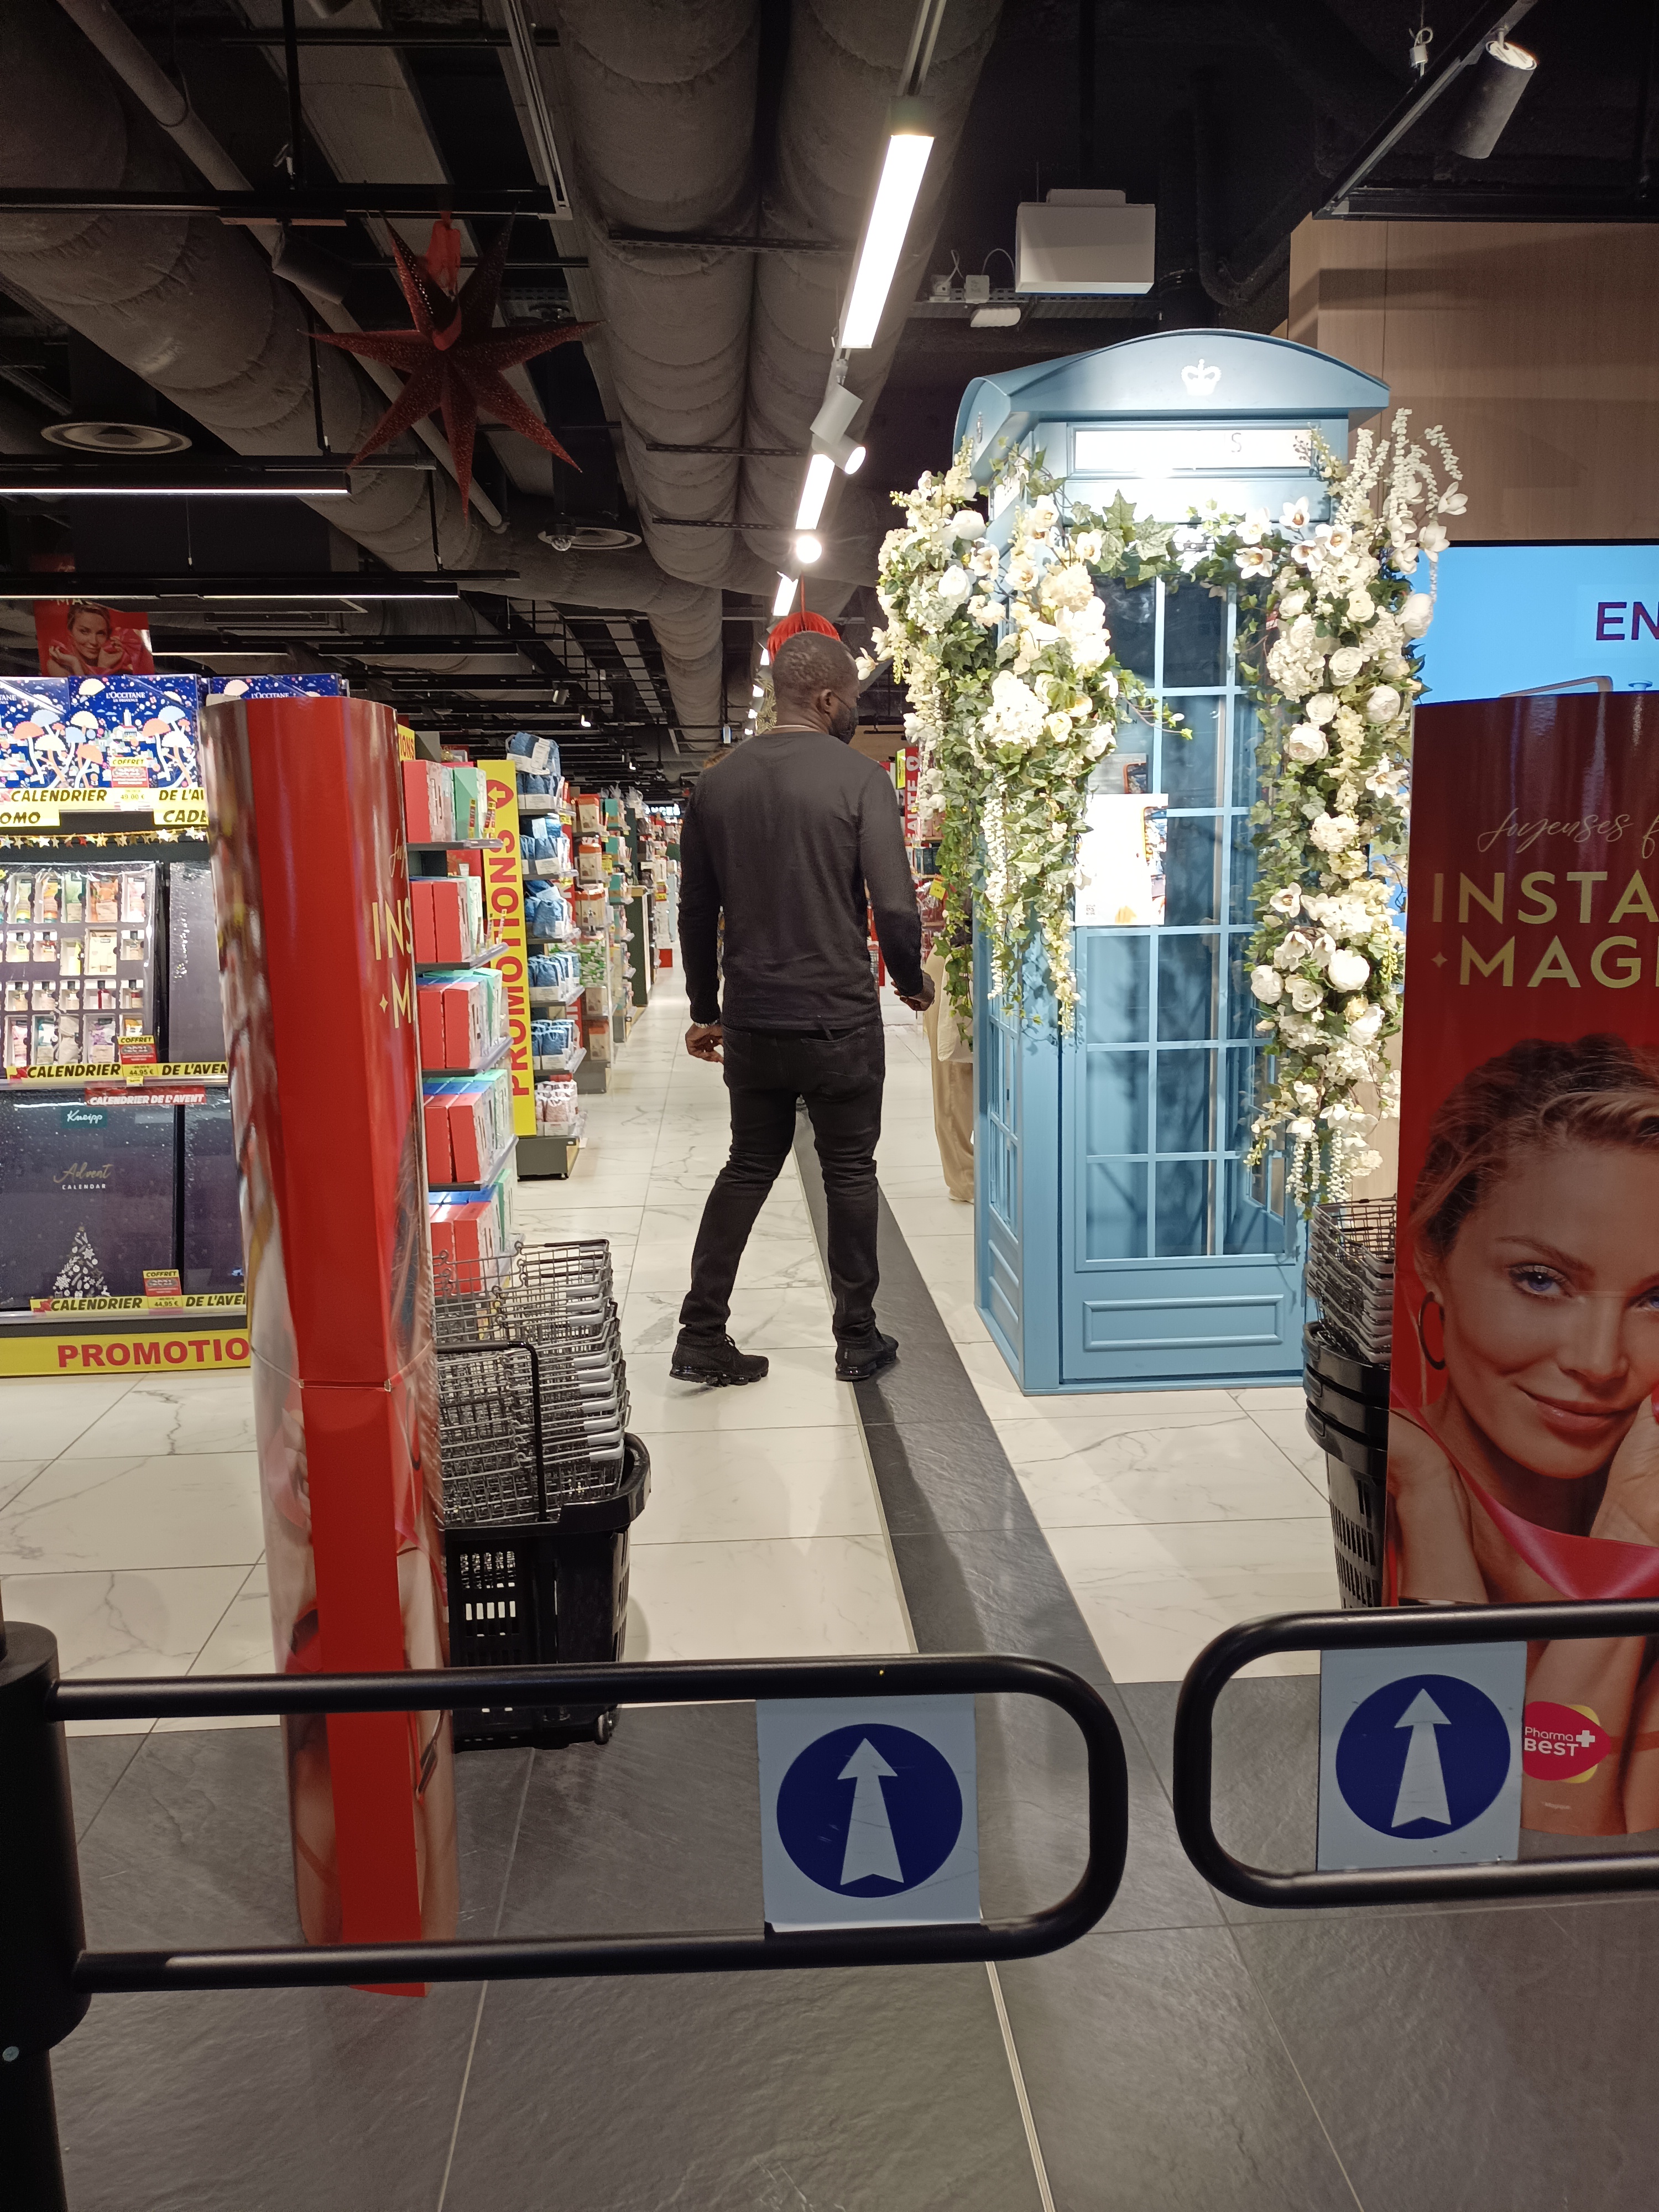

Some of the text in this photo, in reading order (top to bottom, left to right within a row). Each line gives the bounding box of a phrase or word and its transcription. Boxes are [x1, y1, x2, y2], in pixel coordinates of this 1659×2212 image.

[1596, 601, 1659, 640] EN
[11, 790, 107, 801] CALENDRIER
[159, 790, 178, 800] DE
[0, 812, 40, 824] OMO
[1432, 870, 1659, 925] INSTA
[488, 830, 530, 1096] PROMOTIONS
[1460, 935, 1659, 989] MAG
[28, 1063, 121, 1078] CALENDRIER
[162, 1065, 180, 1076] DE
[90, 1095, 149, 1105] CALENDRIER
[150, 1095, 164, 1103] DE
[67, 1109, 103, 1124] Kneipp
[53, 1162, 114, 1183] Advent
[51, 1297, 143, 1311] CALENDRIER
[186, 1296, 205, 1307] DE
[58, 1337, 249, 1368] PROMOTIO
[1525, 1726, 1573, 1741] Pharma
